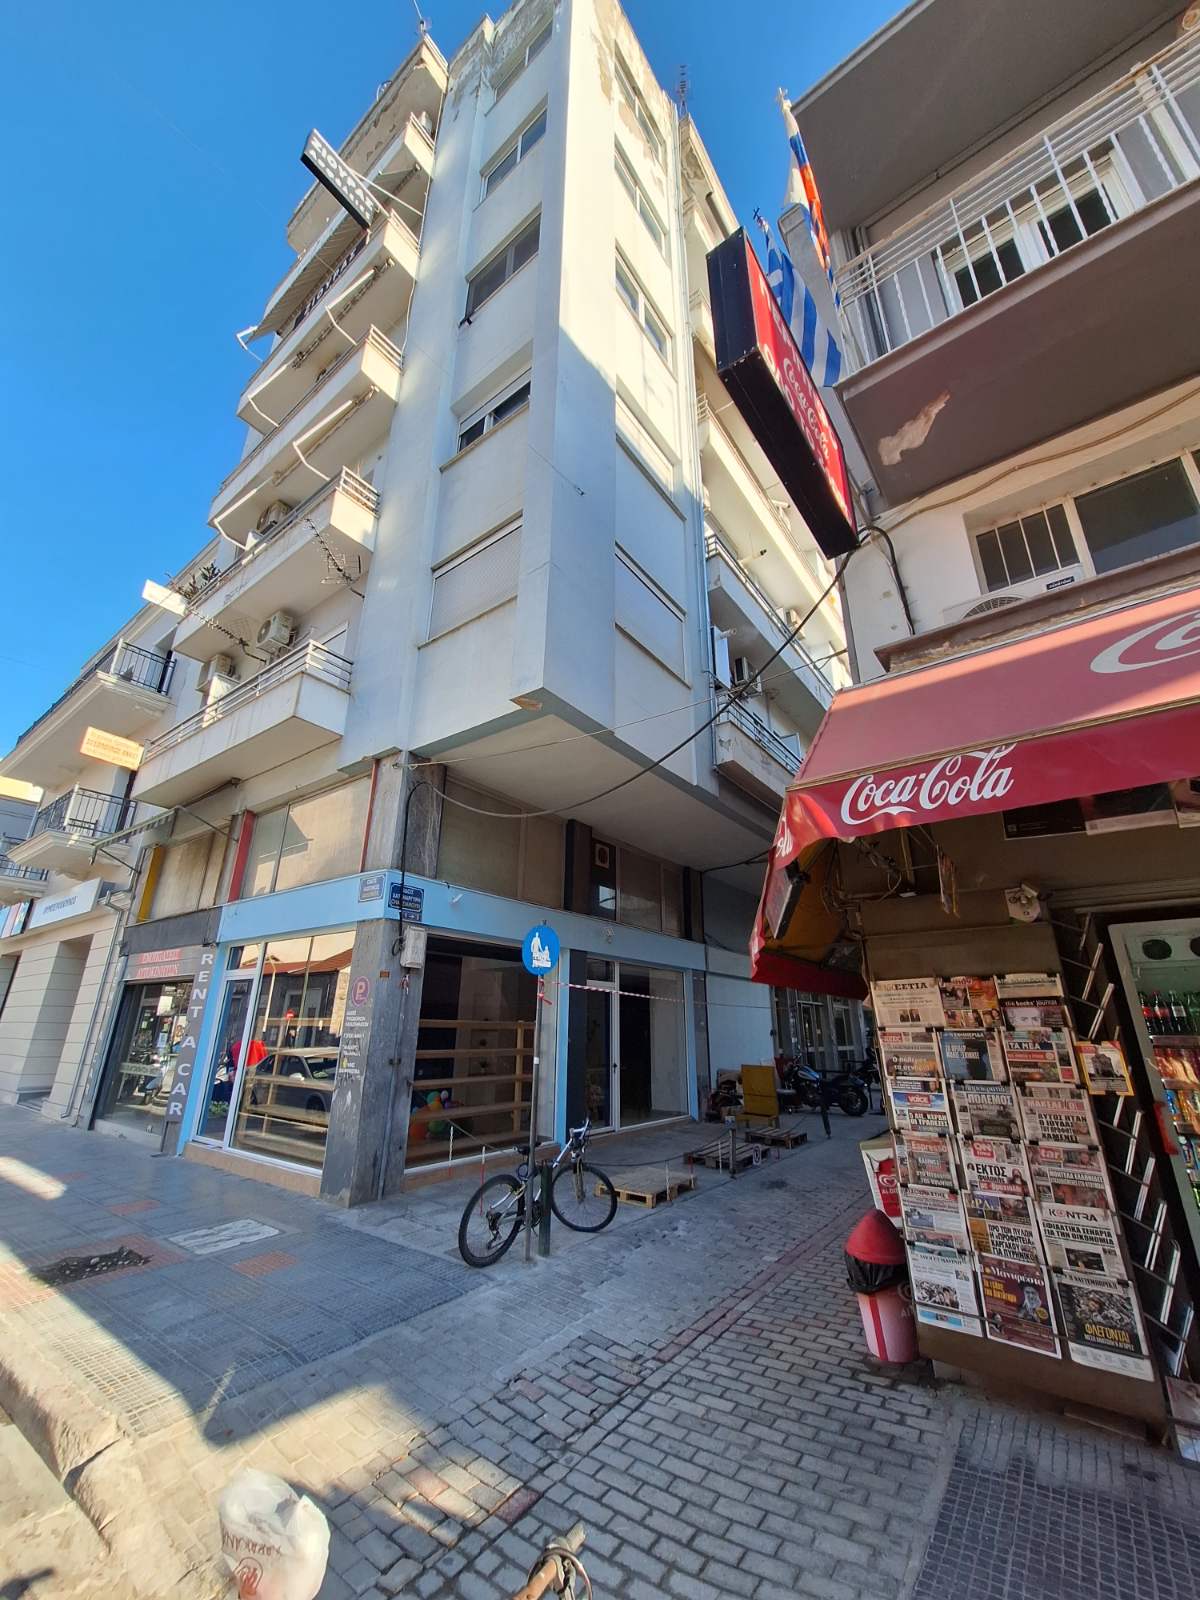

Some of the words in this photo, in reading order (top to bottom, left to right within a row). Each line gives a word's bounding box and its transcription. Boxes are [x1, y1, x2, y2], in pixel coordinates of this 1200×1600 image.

[841, 742, 1016, 825] Coca-Cola
[189, 953, 213, 1018] RENT
[182, 1036, 196, 1049] A
[169, 1063, 191, 1116] CAR
[975, 1163, 1007, 1177] ΕΚΤΟΣ
